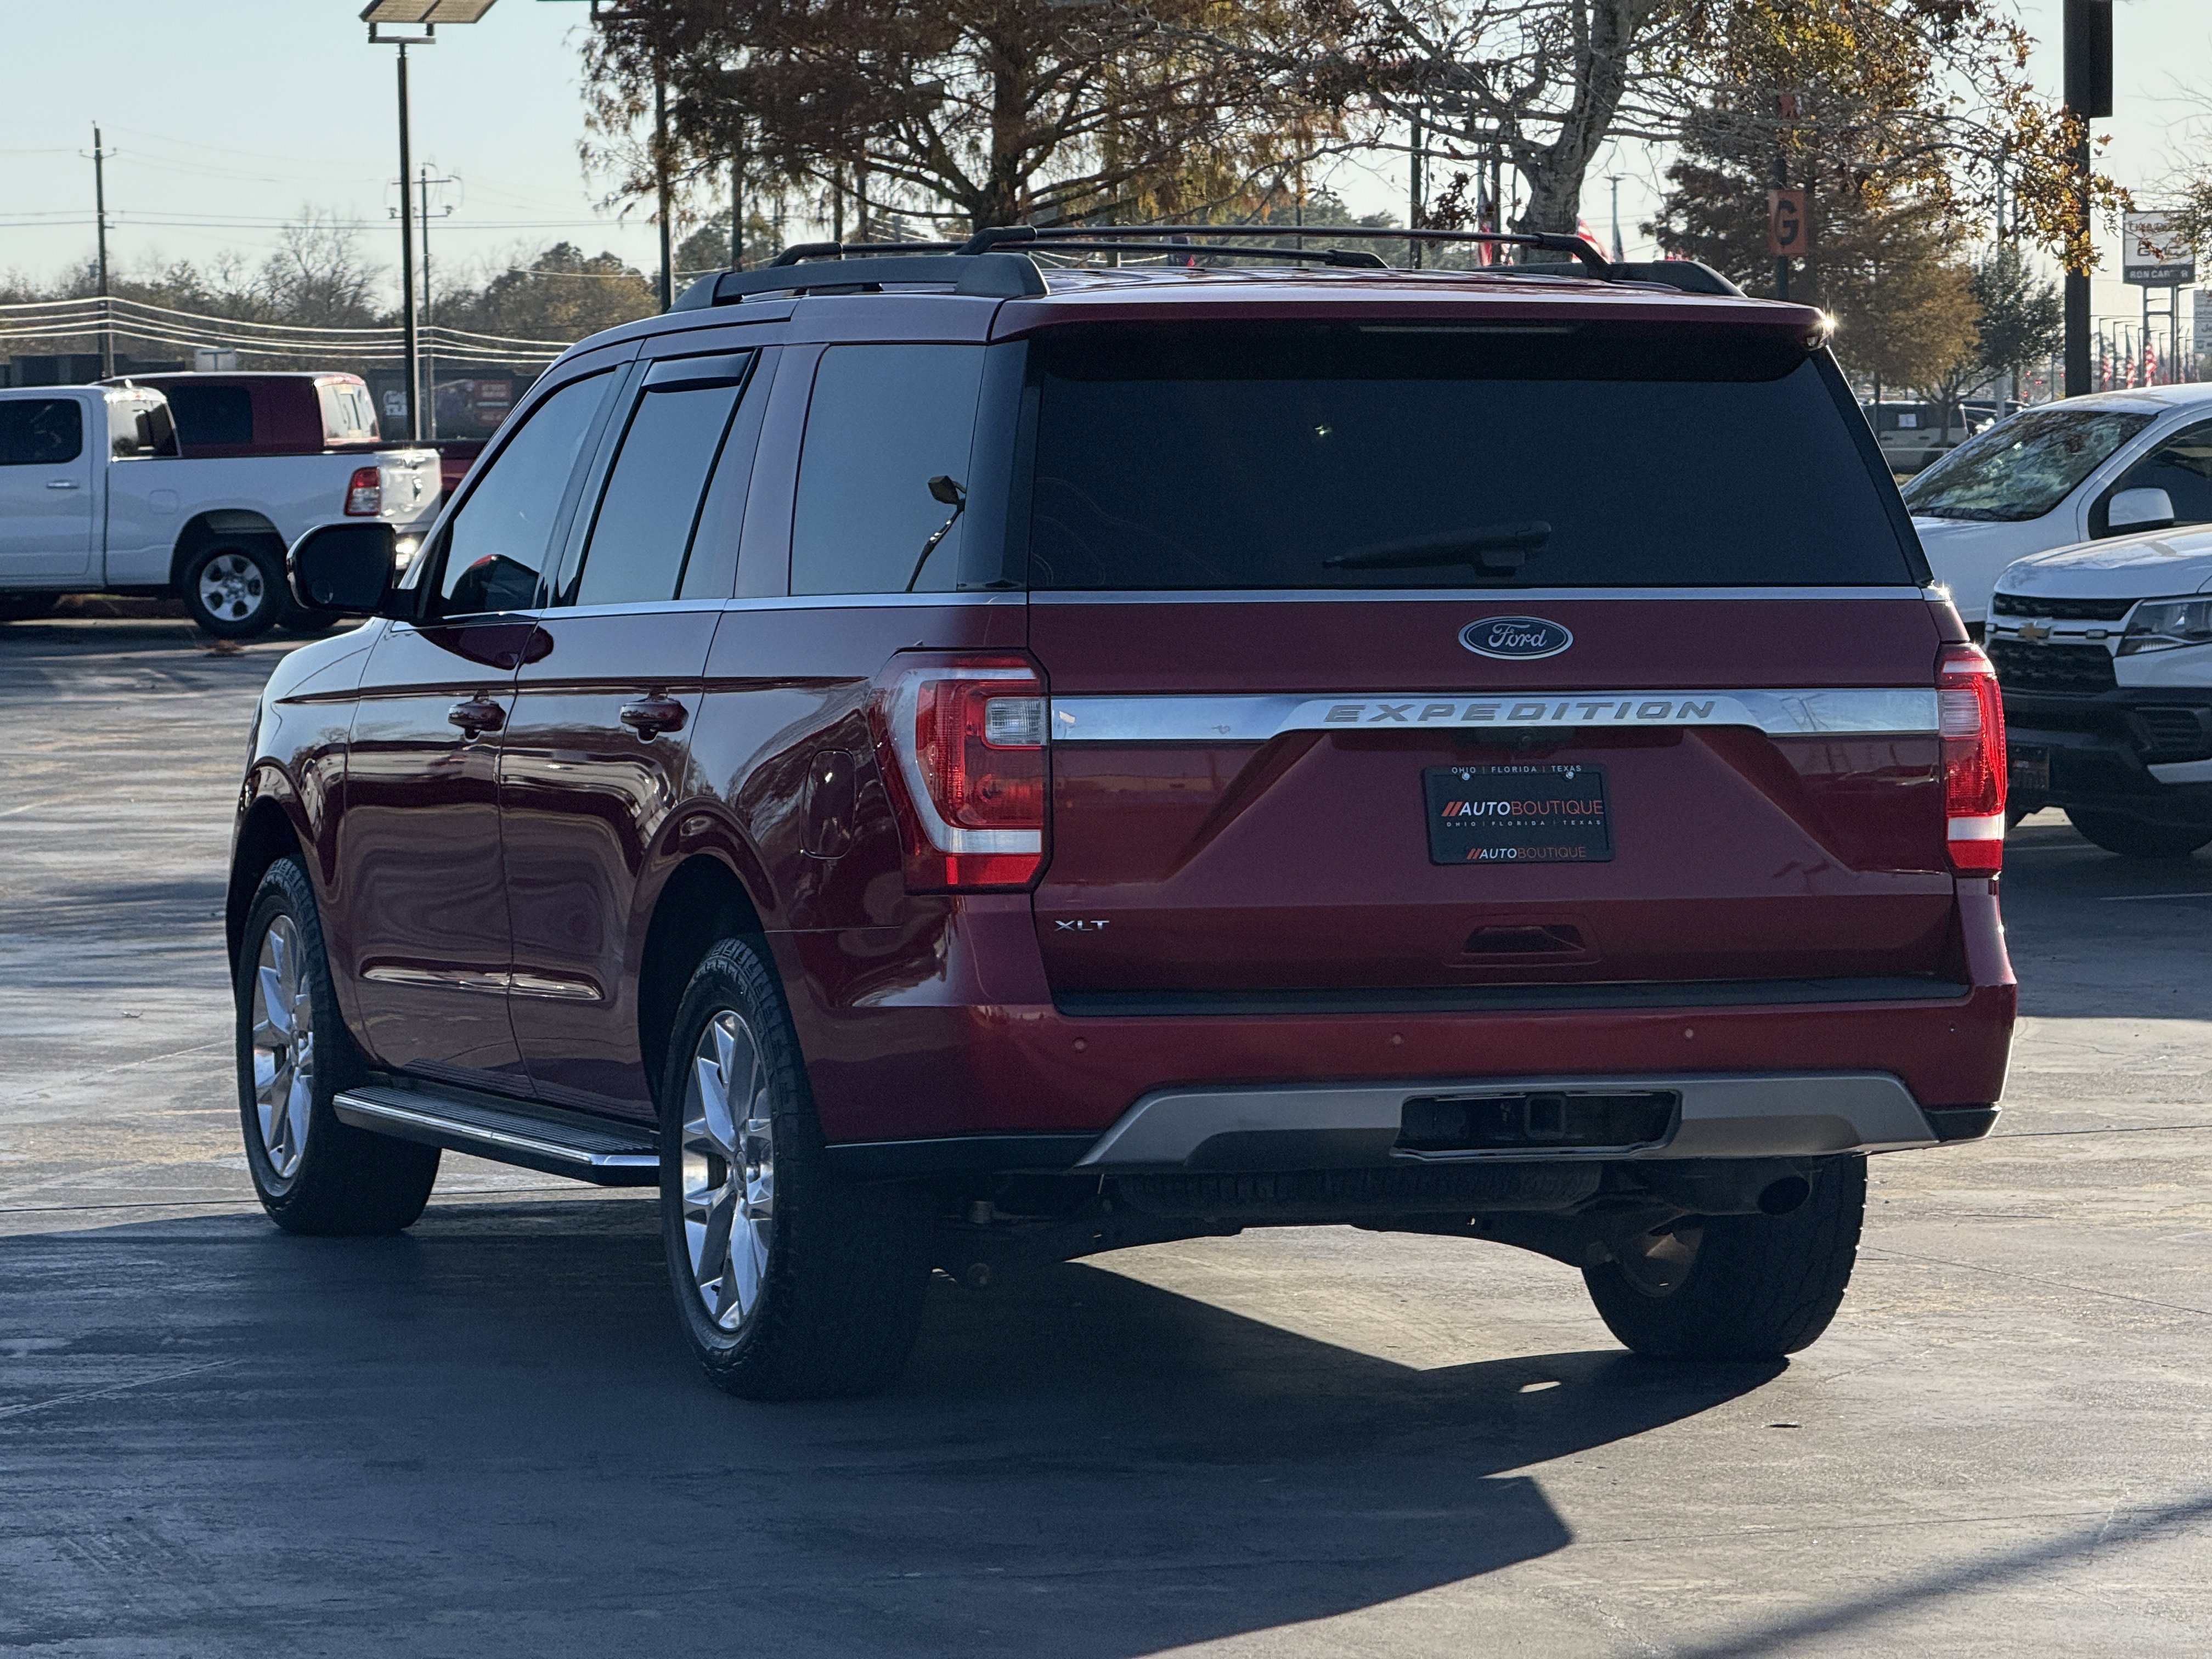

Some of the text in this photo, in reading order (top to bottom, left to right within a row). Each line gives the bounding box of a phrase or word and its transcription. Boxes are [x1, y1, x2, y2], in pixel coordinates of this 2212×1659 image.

[1775, 200, 1799, 245] G
[2151, 270, 2188, 279] CARR
[1488, 623, 1547, 648] Ford
[1324, 701, 1716, 723] EXPEDITION
[1491, 765, 1537, 774] FLORIDA
[1055, 921, 1109, 931] XLT
